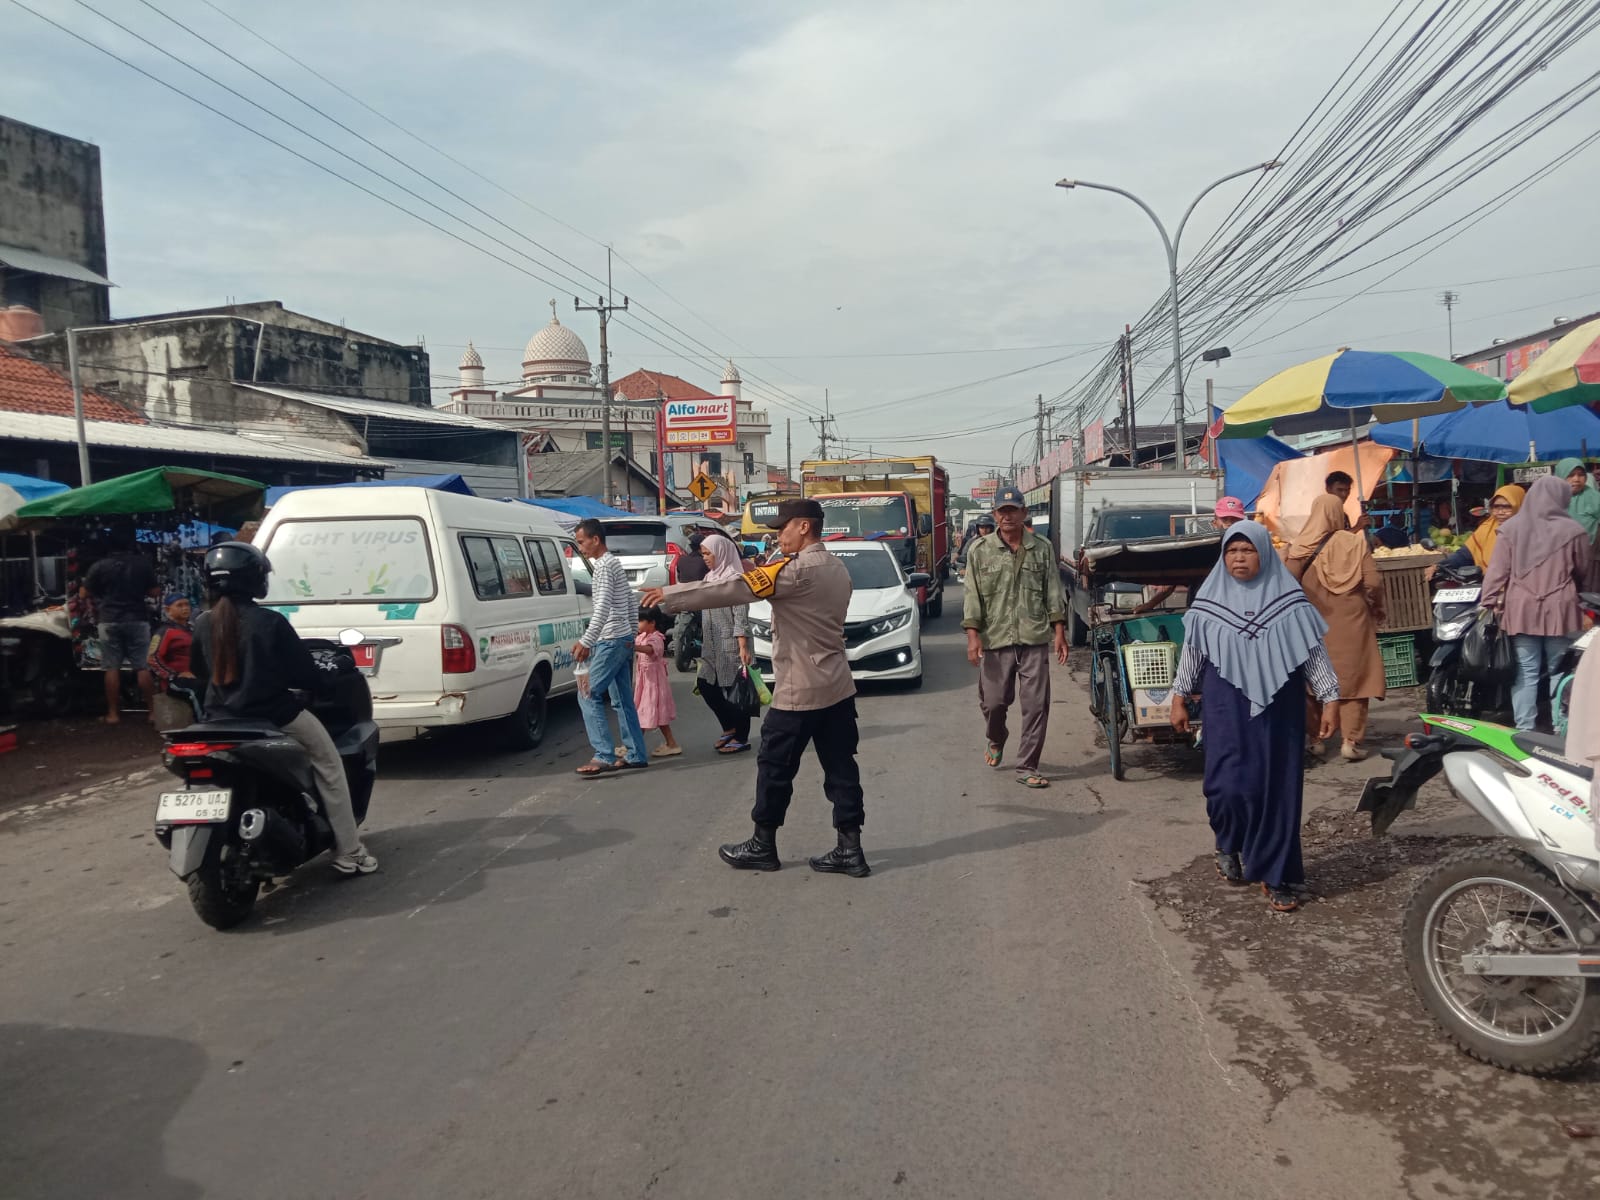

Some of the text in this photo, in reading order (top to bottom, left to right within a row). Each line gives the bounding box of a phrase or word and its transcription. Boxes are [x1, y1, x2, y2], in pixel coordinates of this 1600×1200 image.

[668, 402, 729, 416] Alfamart
[287, 531, 418, 546] IGHT VIRUS
[1537, 773, 1571, 797] Red
[162, 795, 169, 807] E
[175, 794, 203, 807] 5276
